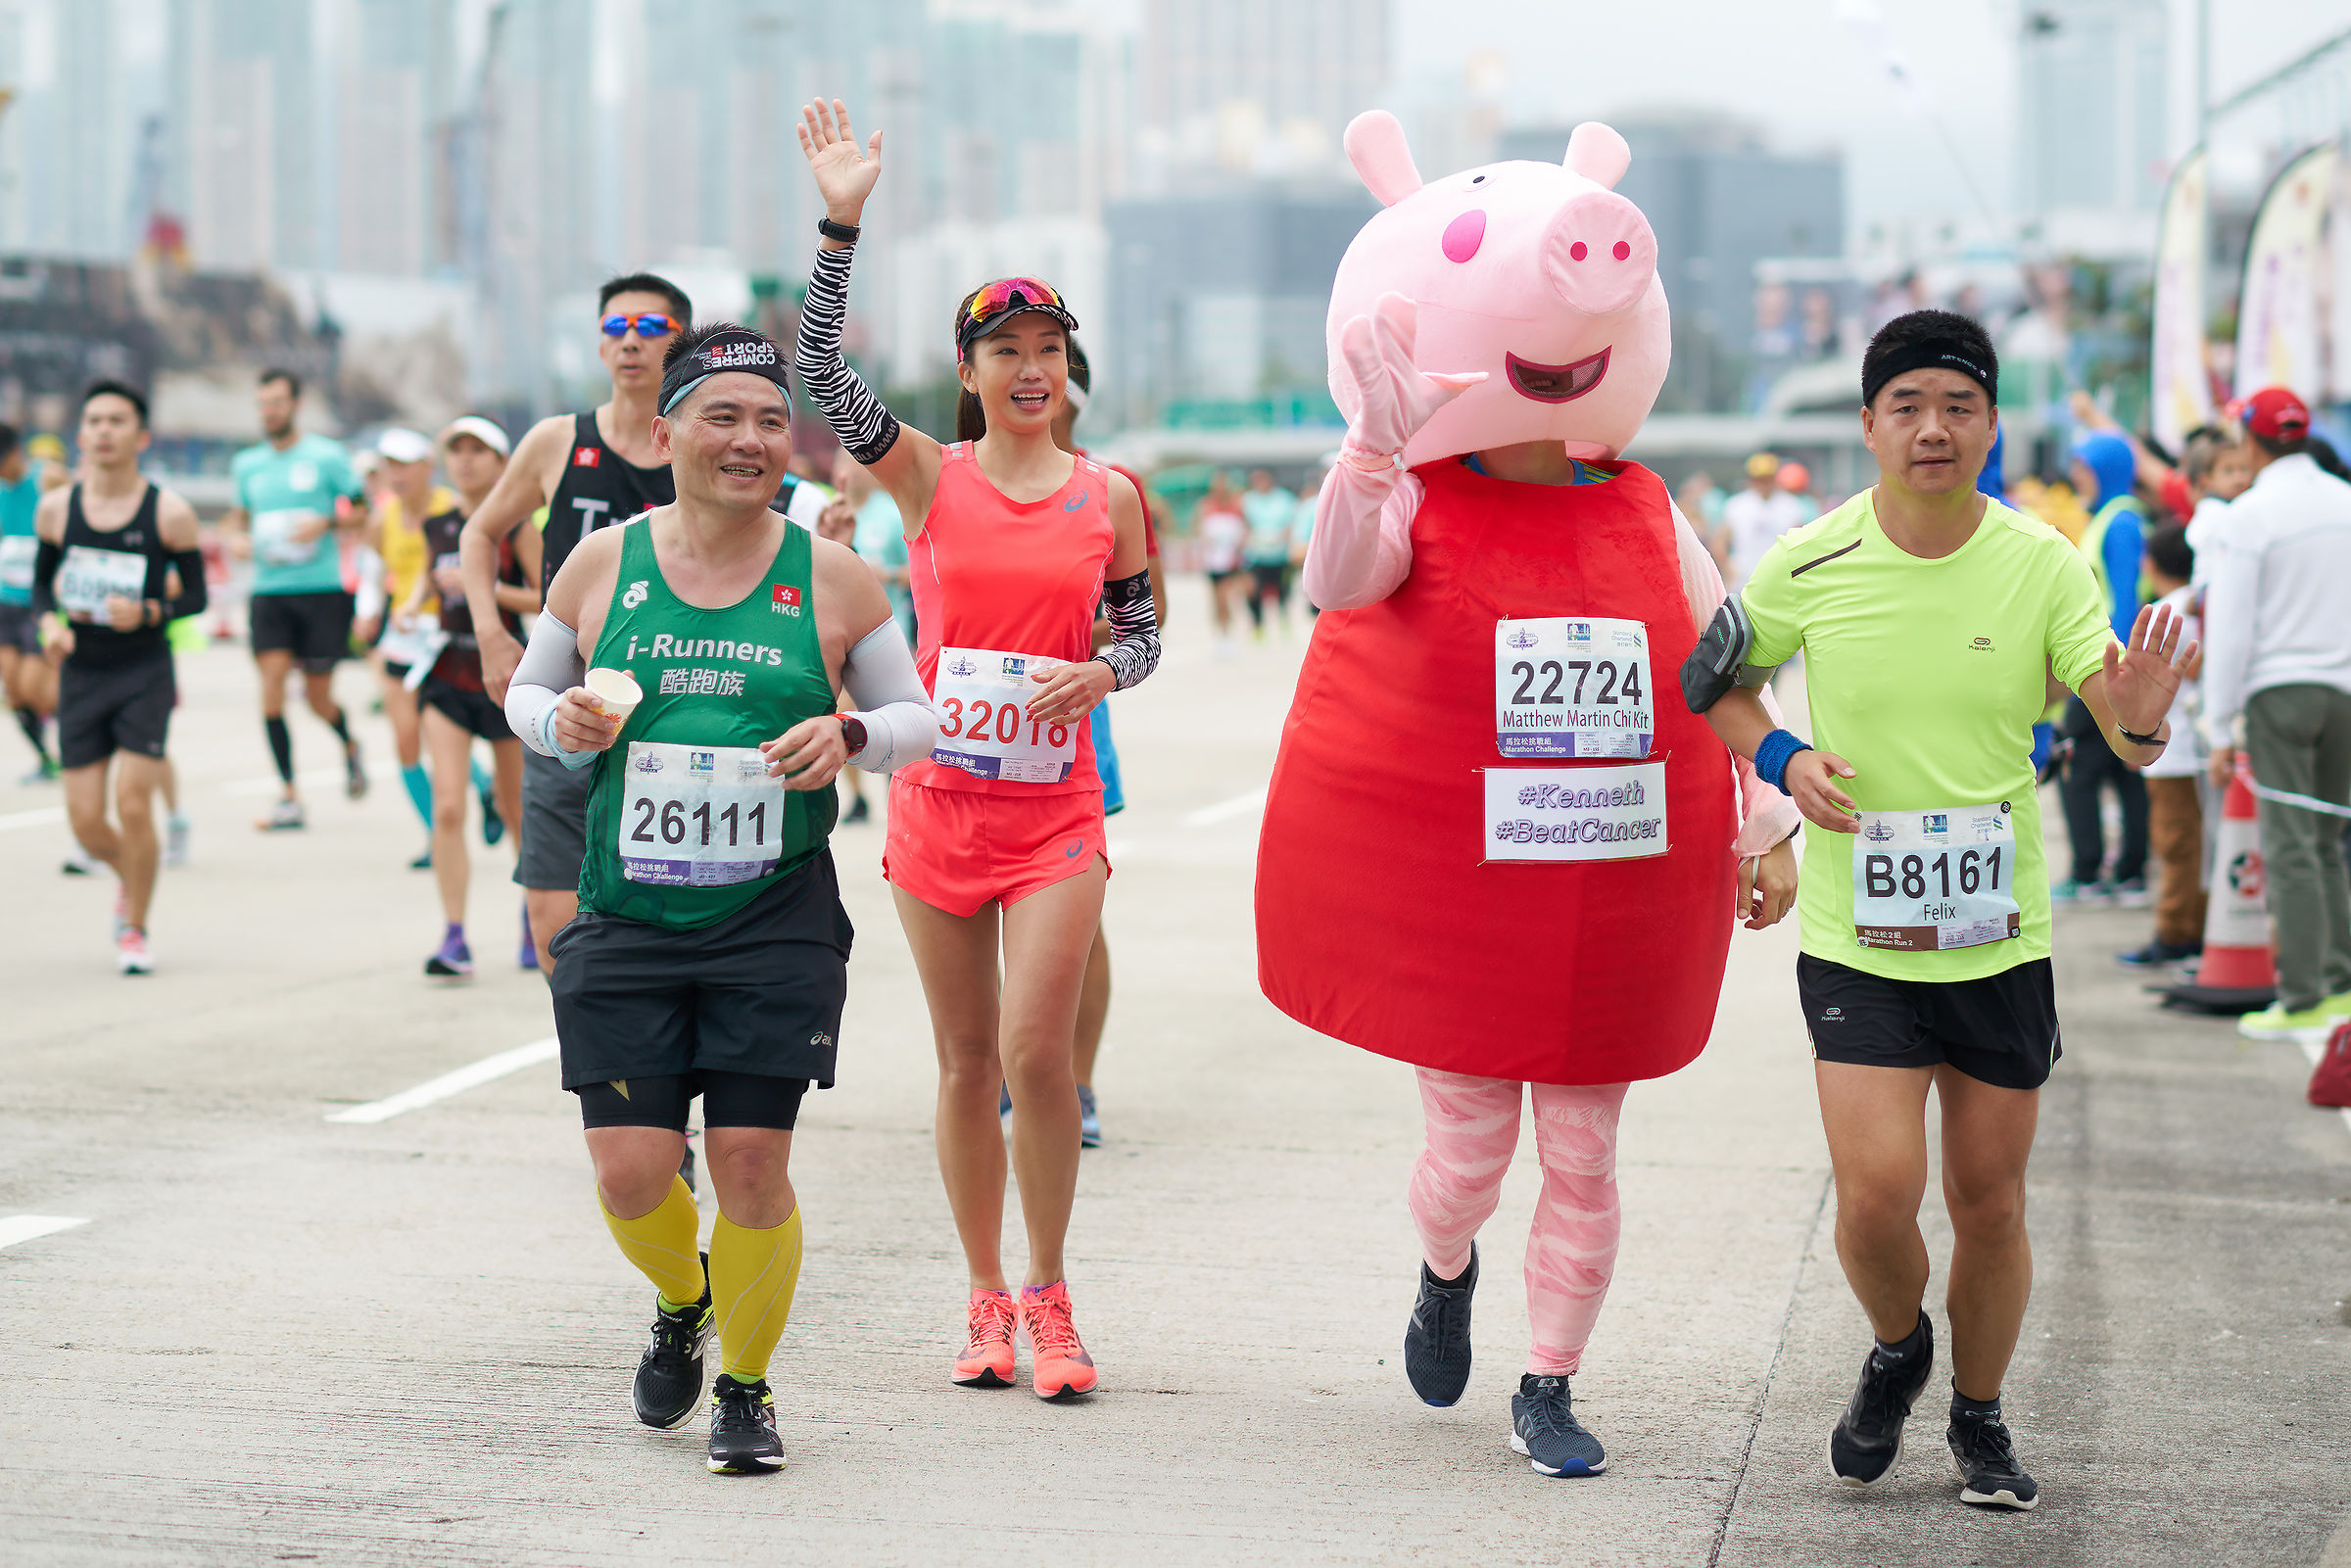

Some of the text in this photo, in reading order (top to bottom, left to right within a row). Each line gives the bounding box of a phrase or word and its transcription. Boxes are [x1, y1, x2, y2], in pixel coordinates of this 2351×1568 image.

[771, 601, 800, 618] HKG
[626, 634, 783, 667] i-Runners
[659, 668, 746, 697] 酷跑族
[1511, 660, 1643, 706] 22724
[1503, 709, 1650, 729] Matthew Martin Chi Kit
[1517, 780, 1645, 809] #Kenneth
[631, 797, 766, 846] 26111
[1495, 817, 1661, 843] #BeatCancer
[1865, 846, 2001, 899] B8161
[1924, 903, 1956, 921] Felix
